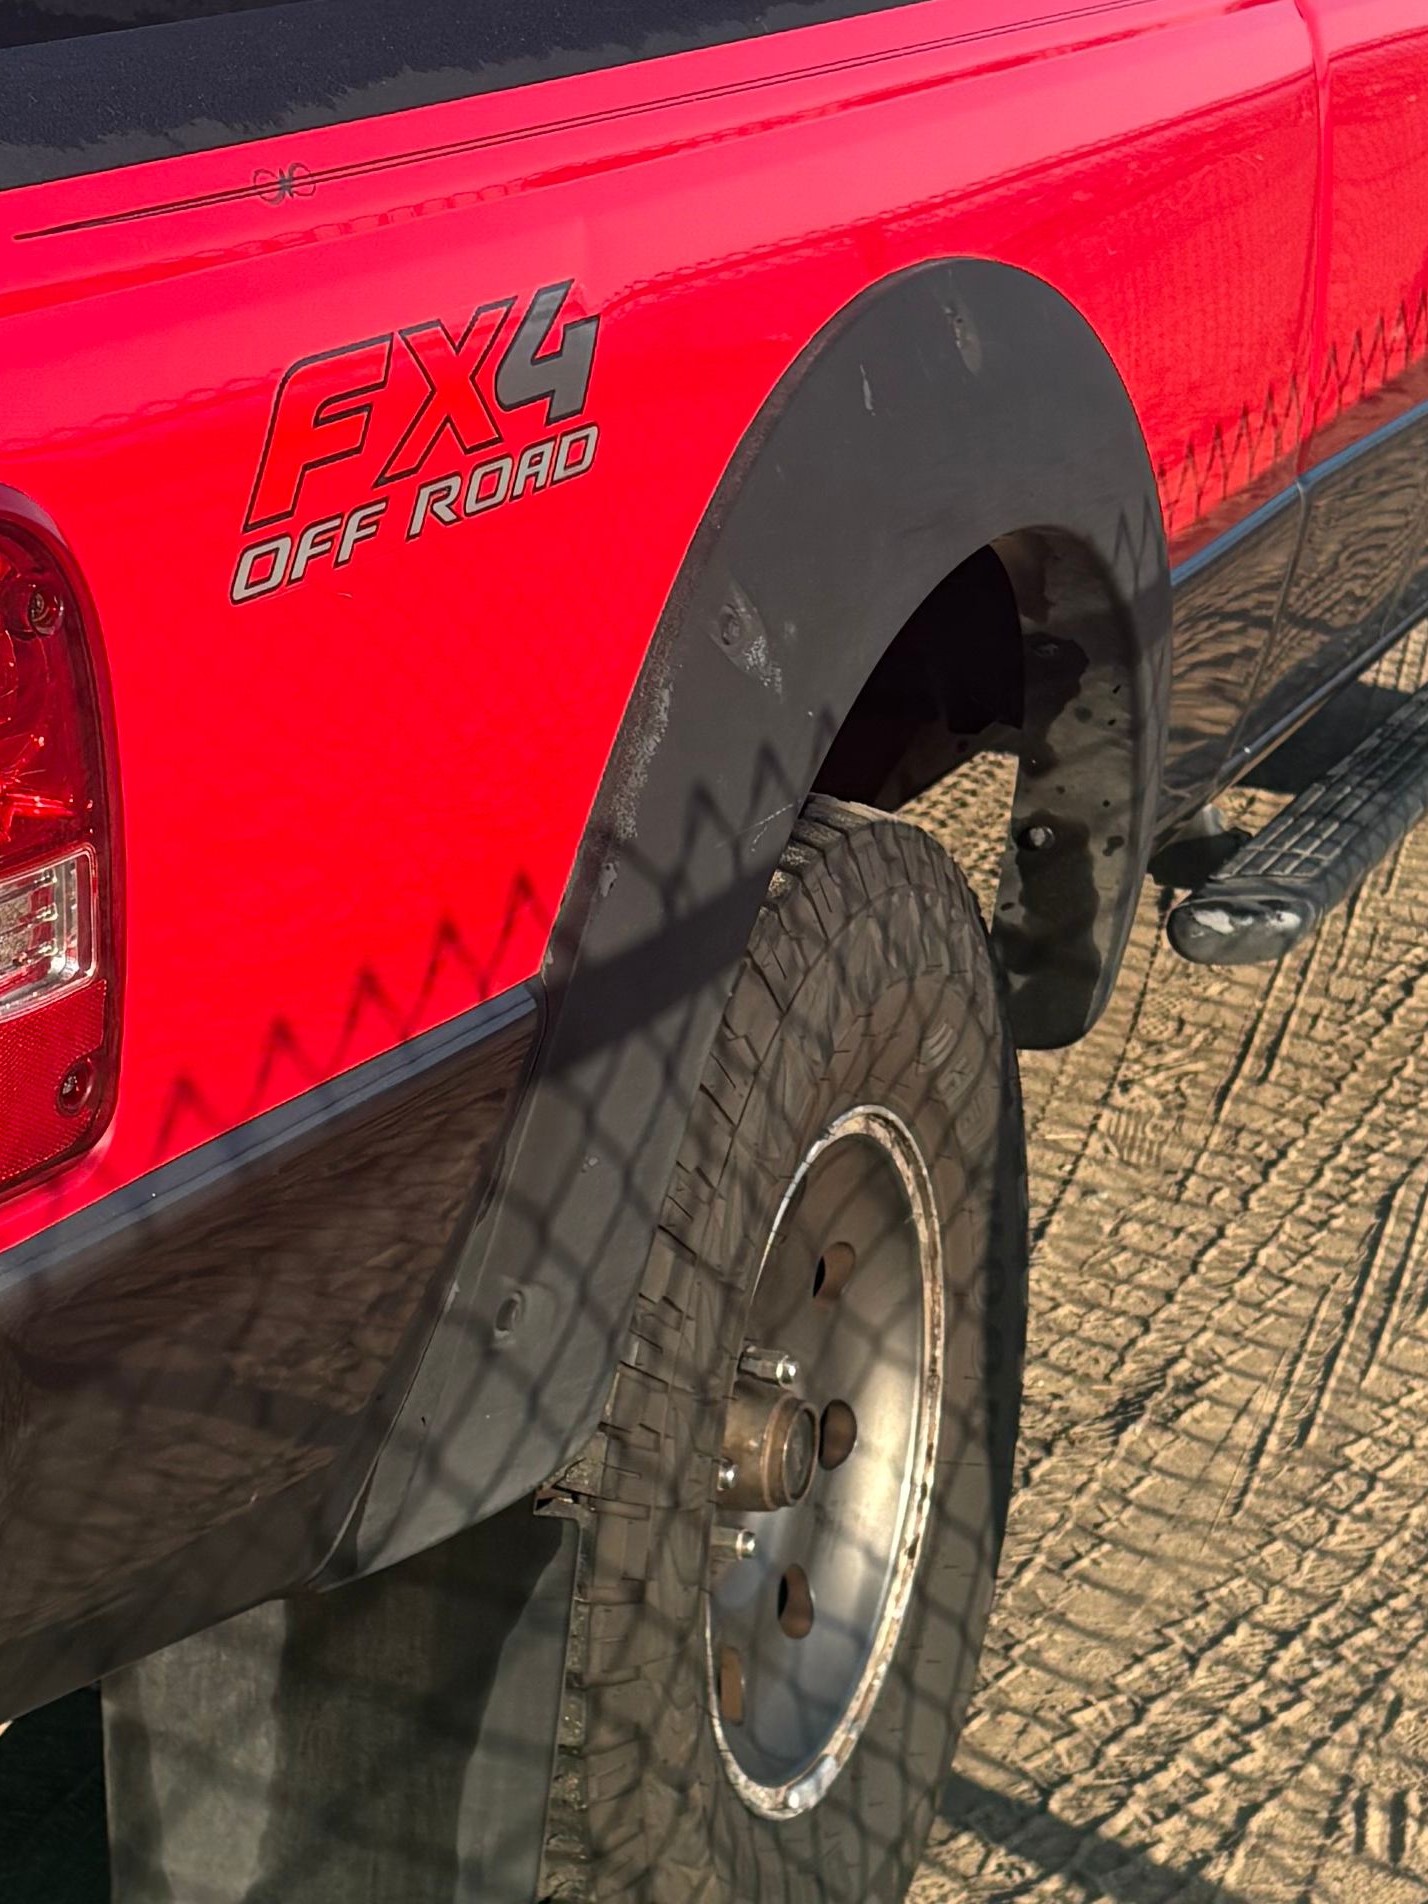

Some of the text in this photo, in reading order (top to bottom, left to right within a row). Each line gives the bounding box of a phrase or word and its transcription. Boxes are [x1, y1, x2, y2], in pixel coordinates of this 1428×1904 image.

[230, 422, 599, 604] OFF ROAD
[242, 279, 600, 533] FX4
